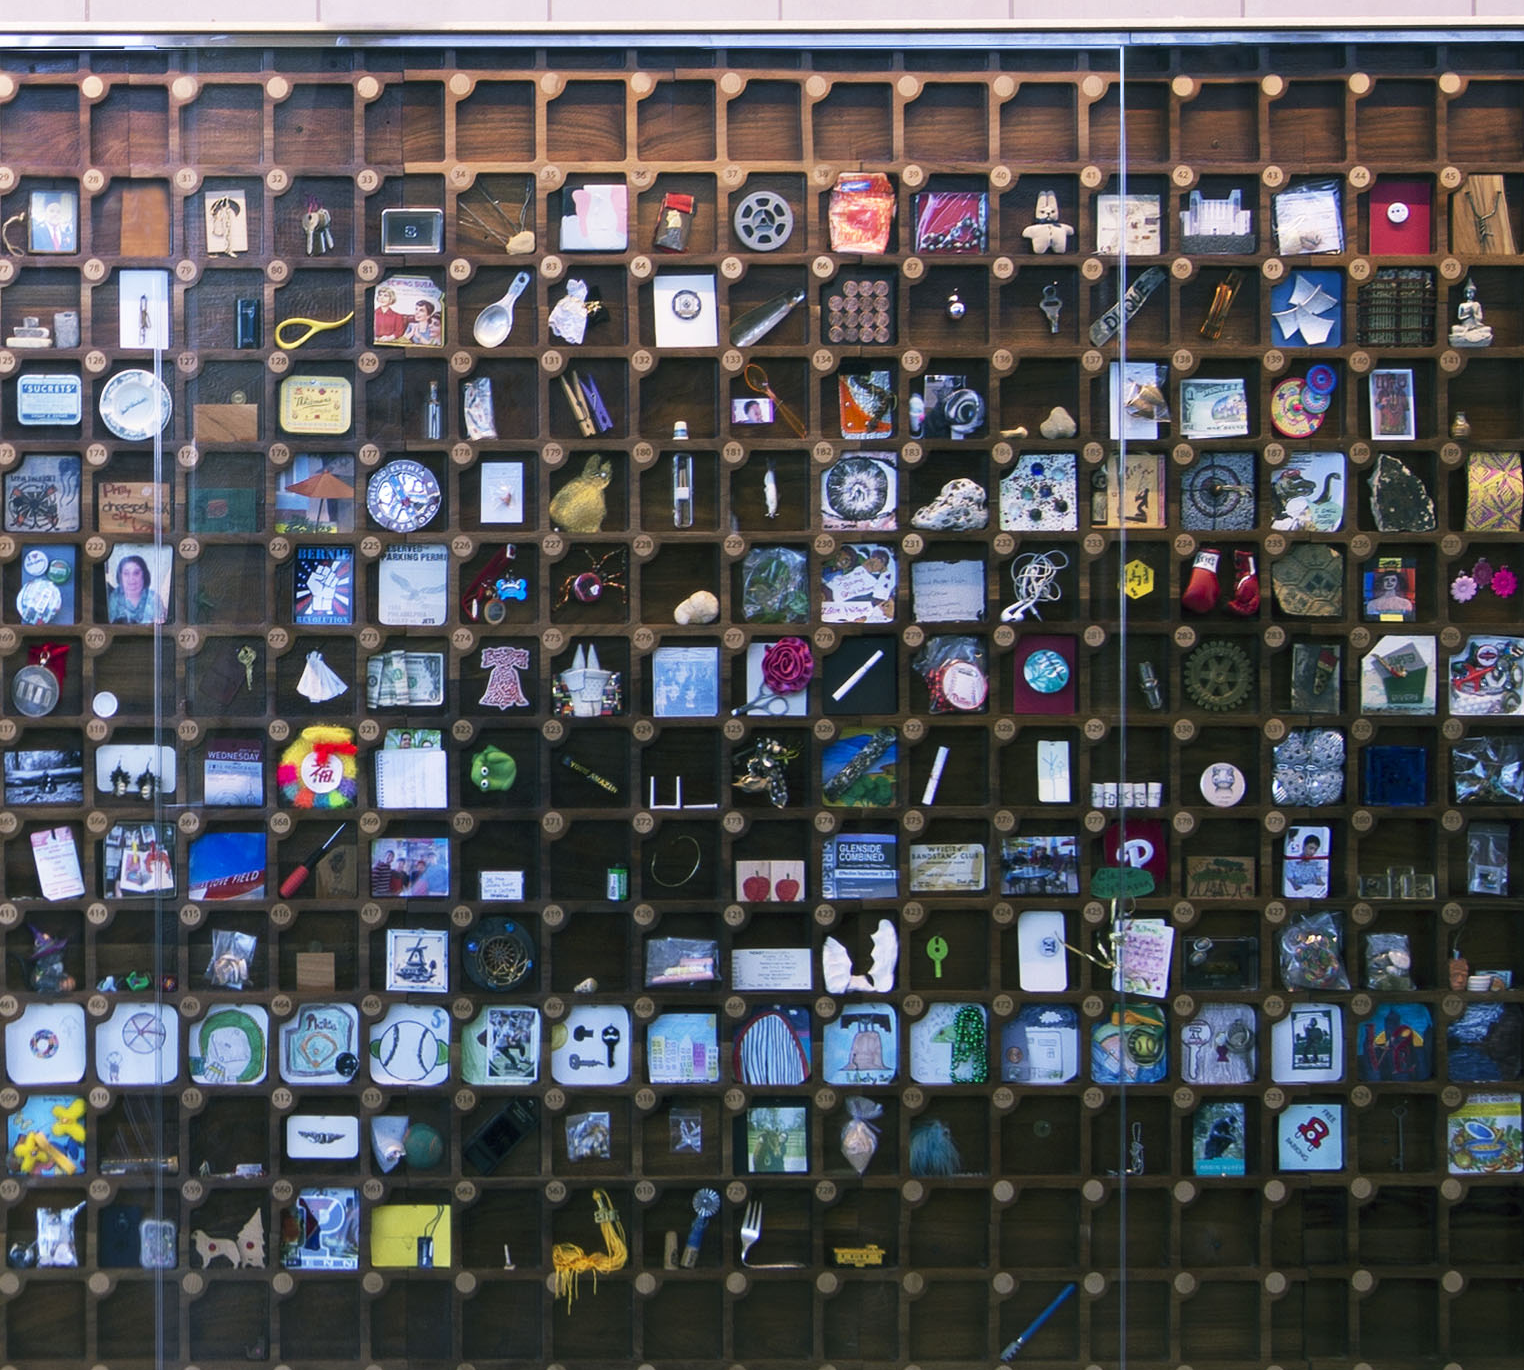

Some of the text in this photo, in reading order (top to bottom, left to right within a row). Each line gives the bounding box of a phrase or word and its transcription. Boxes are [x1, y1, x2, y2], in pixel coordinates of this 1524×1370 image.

[995, 171, 1007, 181] 40
[725, 262, 737, 272] 85
[1444, 262, 1457, 272] 93
[1266, 354, 1283, 364] 139
[545, 448, 562, 457] 179
[298, 548, 349, 560] BERNIE
[208, 751, 260, 761] WEDNESDAY
[838, 844, 881, 853] GLENSIDE
[838, 853, 885, 862] COMBINED
[1322, 1109, 1337, 1124] FREE
